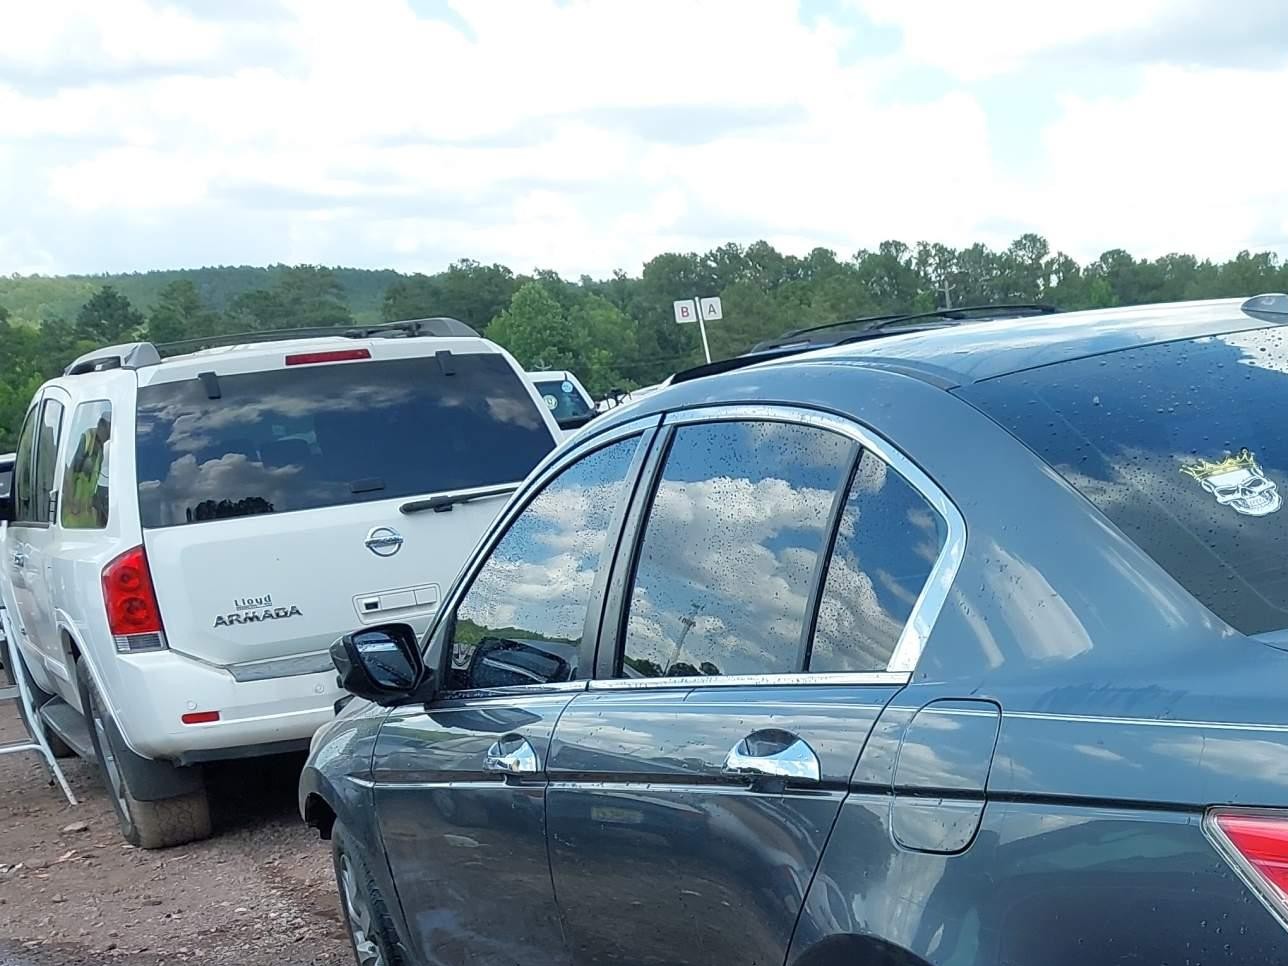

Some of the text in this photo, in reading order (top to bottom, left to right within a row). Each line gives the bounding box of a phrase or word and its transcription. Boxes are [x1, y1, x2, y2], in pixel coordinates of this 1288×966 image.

[680, 306, 690, 318] B
[707, 303, 718, 315] A
[234, 594, 272, 607] Lloyd
[213, 605, 303, 628] ARMADA
